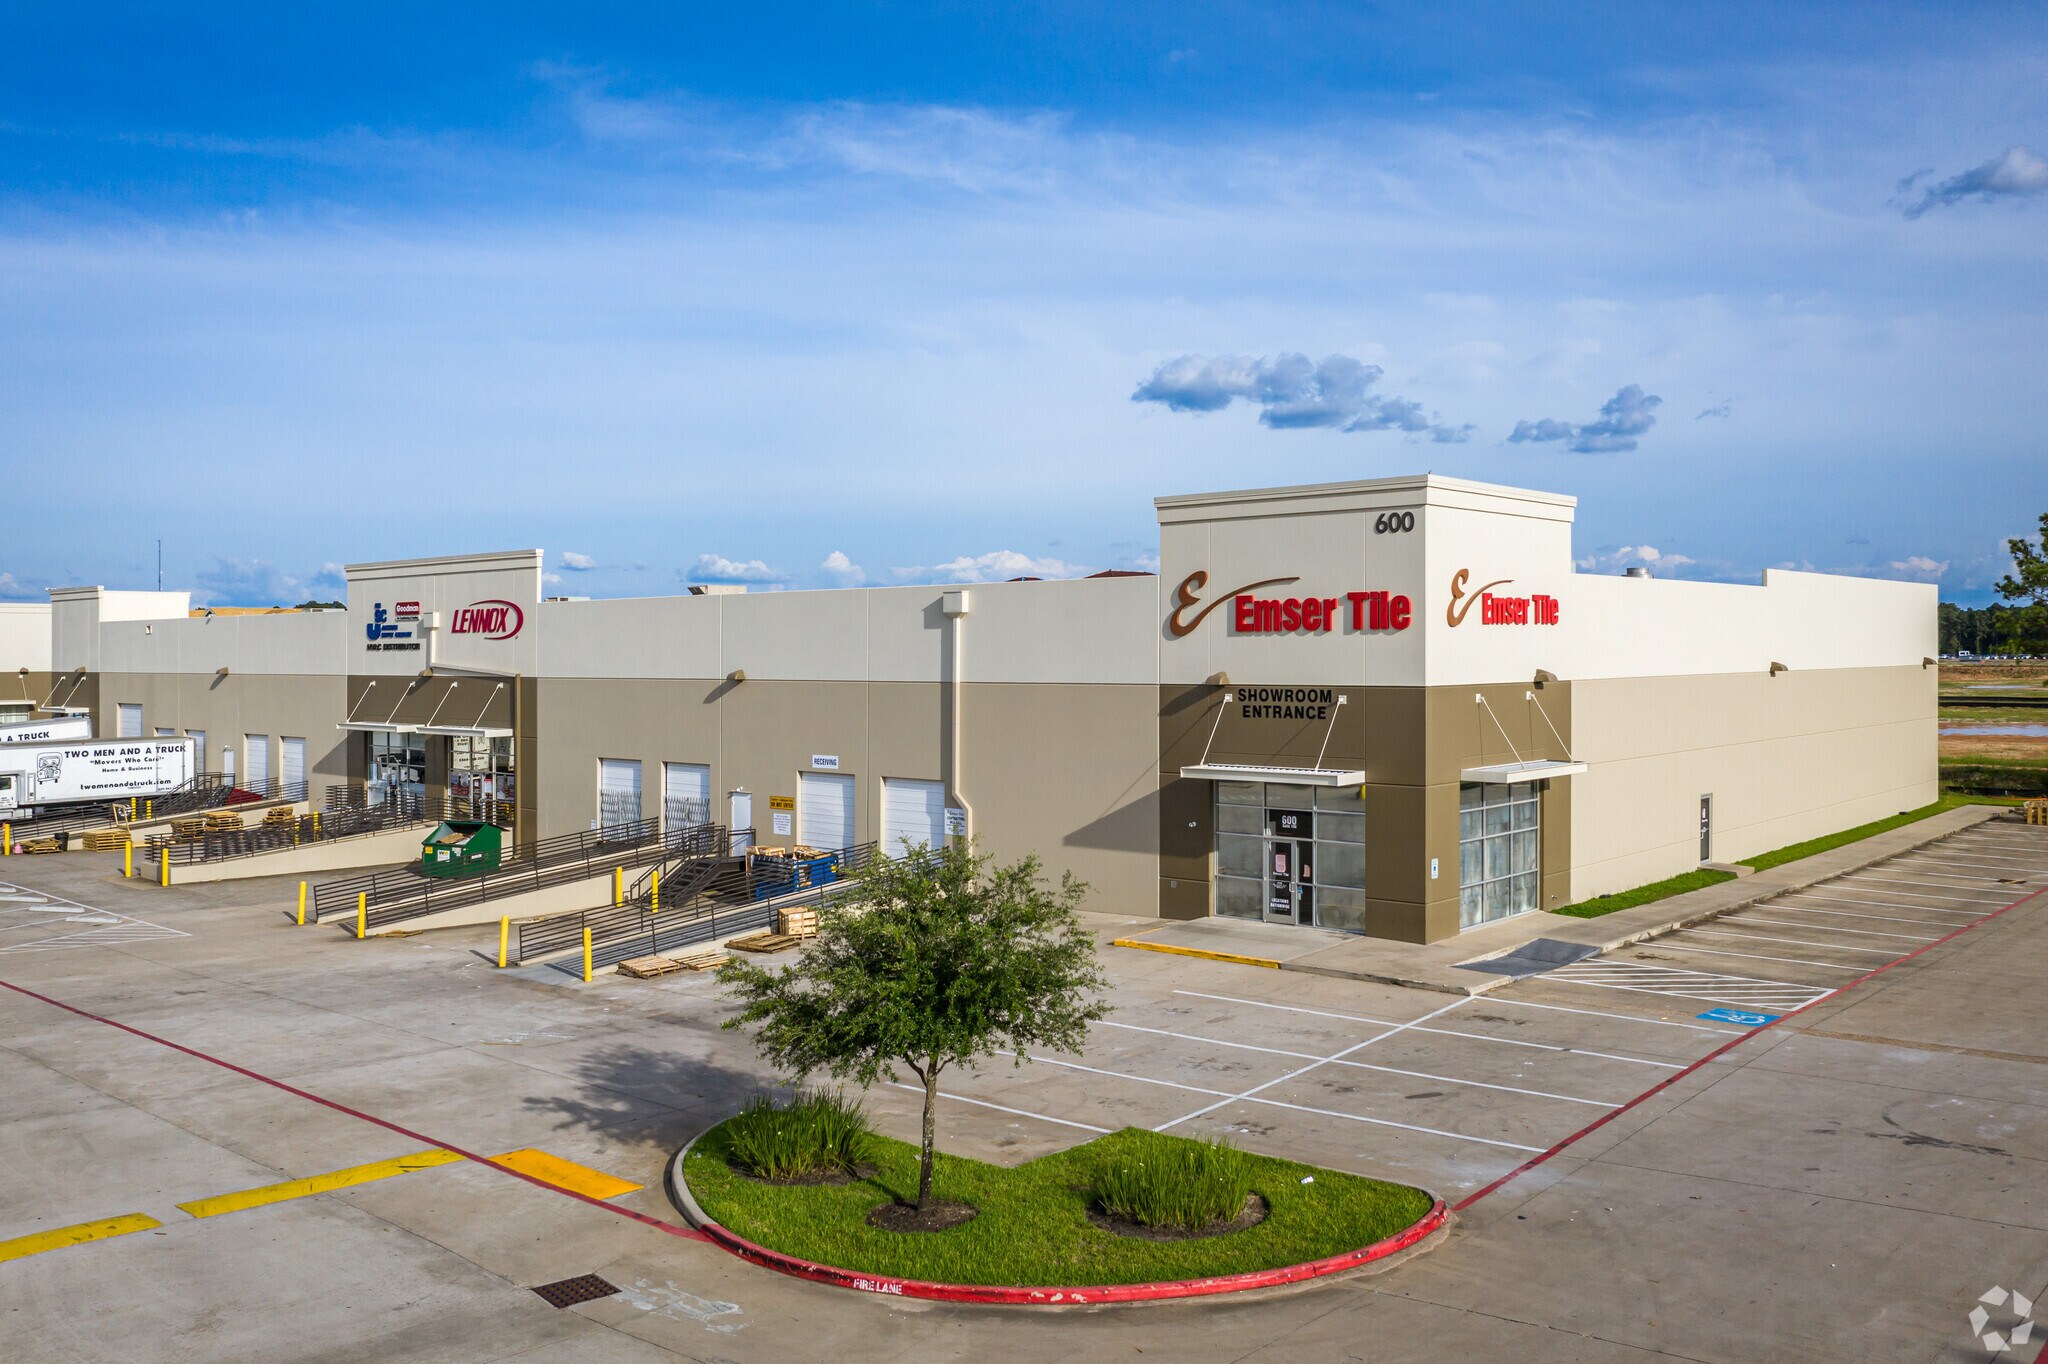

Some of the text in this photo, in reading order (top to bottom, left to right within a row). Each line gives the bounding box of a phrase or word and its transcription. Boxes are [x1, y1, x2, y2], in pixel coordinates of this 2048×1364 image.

[1375, 511, 1415, 534] 600
[1235, 591, 1412, 632] Emser Tile
[1482, 593, 1559, 625] Emser Tile
[451, 608, 509, 634] LENNOX
[383, 643, 420, 651] DISTRIBUTOR
[1238, 689, 1332, 703] SHOWROOM
[1242, 705, 1327, 720] ENTRANCE
[18, 731, 50, 741] TRUCK
[65, 750, 89, 758] TWO
[94, 749, 115, 757] MEN
[156, 745, 186, 753] TRUCK
[813, 757, 837, 766] RECEIVING
[80, 779, 172, 790] twomenandatruck.com
[1282, 815, 1297, 824] 600
[853, 1278, 902, 1294] FIRE LANE
